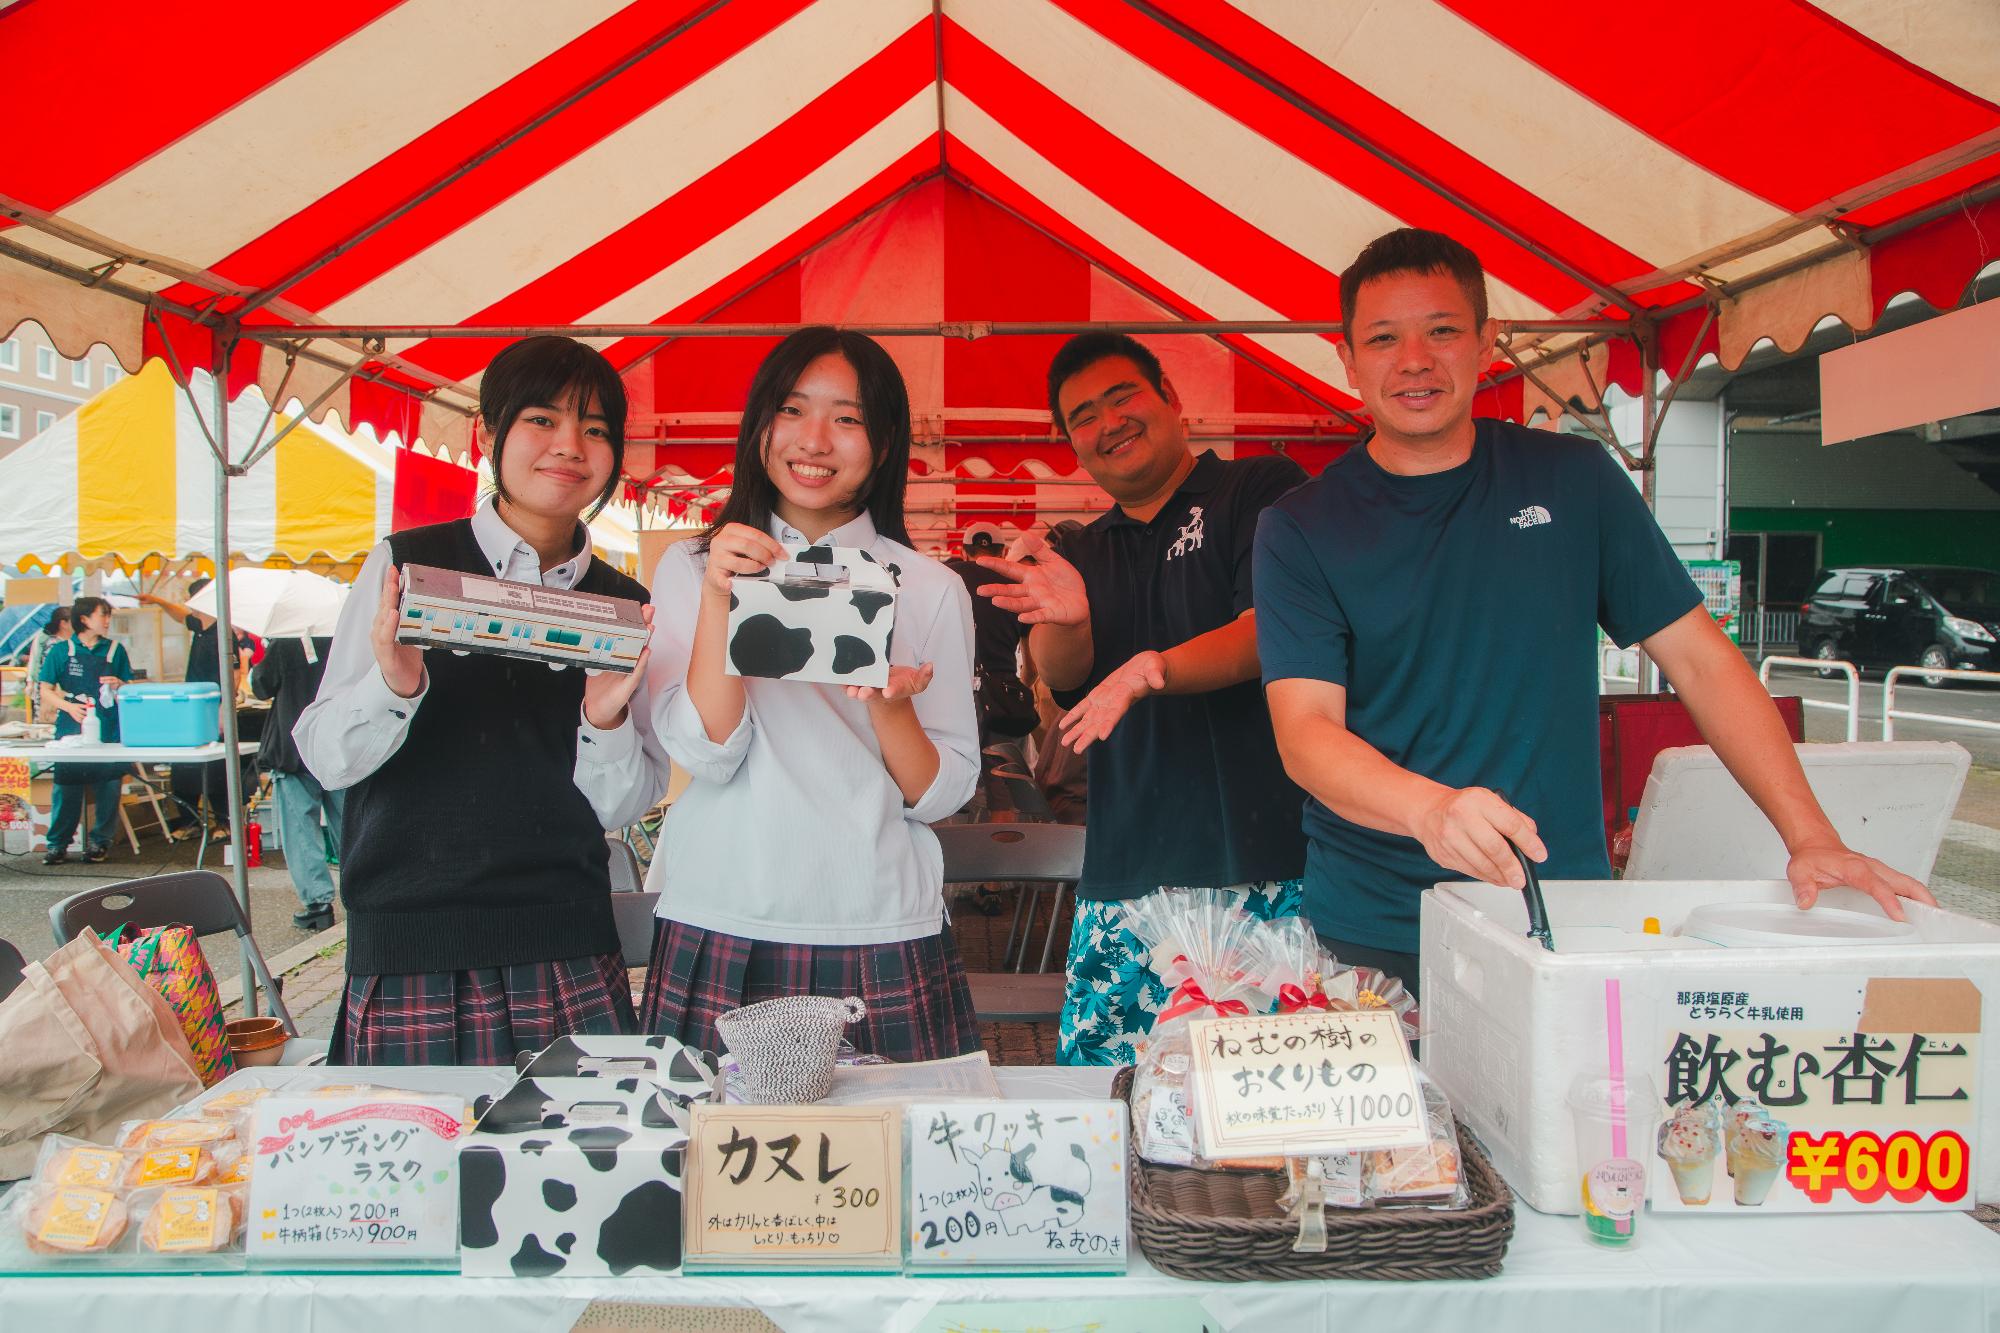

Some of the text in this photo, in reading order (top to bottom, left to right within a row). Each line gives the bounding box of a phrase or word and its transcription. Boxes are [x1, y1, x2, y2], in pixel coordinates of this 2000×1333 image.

[1510, 511, 1538, 524] NORTH
[1519, 506, 1534, 517] THE
[1519, 518, 1538, 529] FACE
[1677, 991, 1750, 1006] 那須塩原産
[1689, 1006, 1804, 1021] とちらく牛乳使用
[1210, 1025, 1378, 1059] ねむの樹の
[1232, 1058, 1377, 1098] おくりもの
[1663, 1032, 1969, 1108] 飲む杏仁
[1331, 1091, 1413, 1126] ¥1000
[269, 1124, 420, 1169] パンプディング
[927, 1107, 1080, 1164] 牛クッキー
[353, 1159, 422, 1184] ラスク
[716, 1125, 853, 1186] カヌレ
[1791, 1136, 1963, 1191] ¥600
[919, 1210, 998, 1251] 200円
[1044, 1229, 1122, 1256] ねむのき
